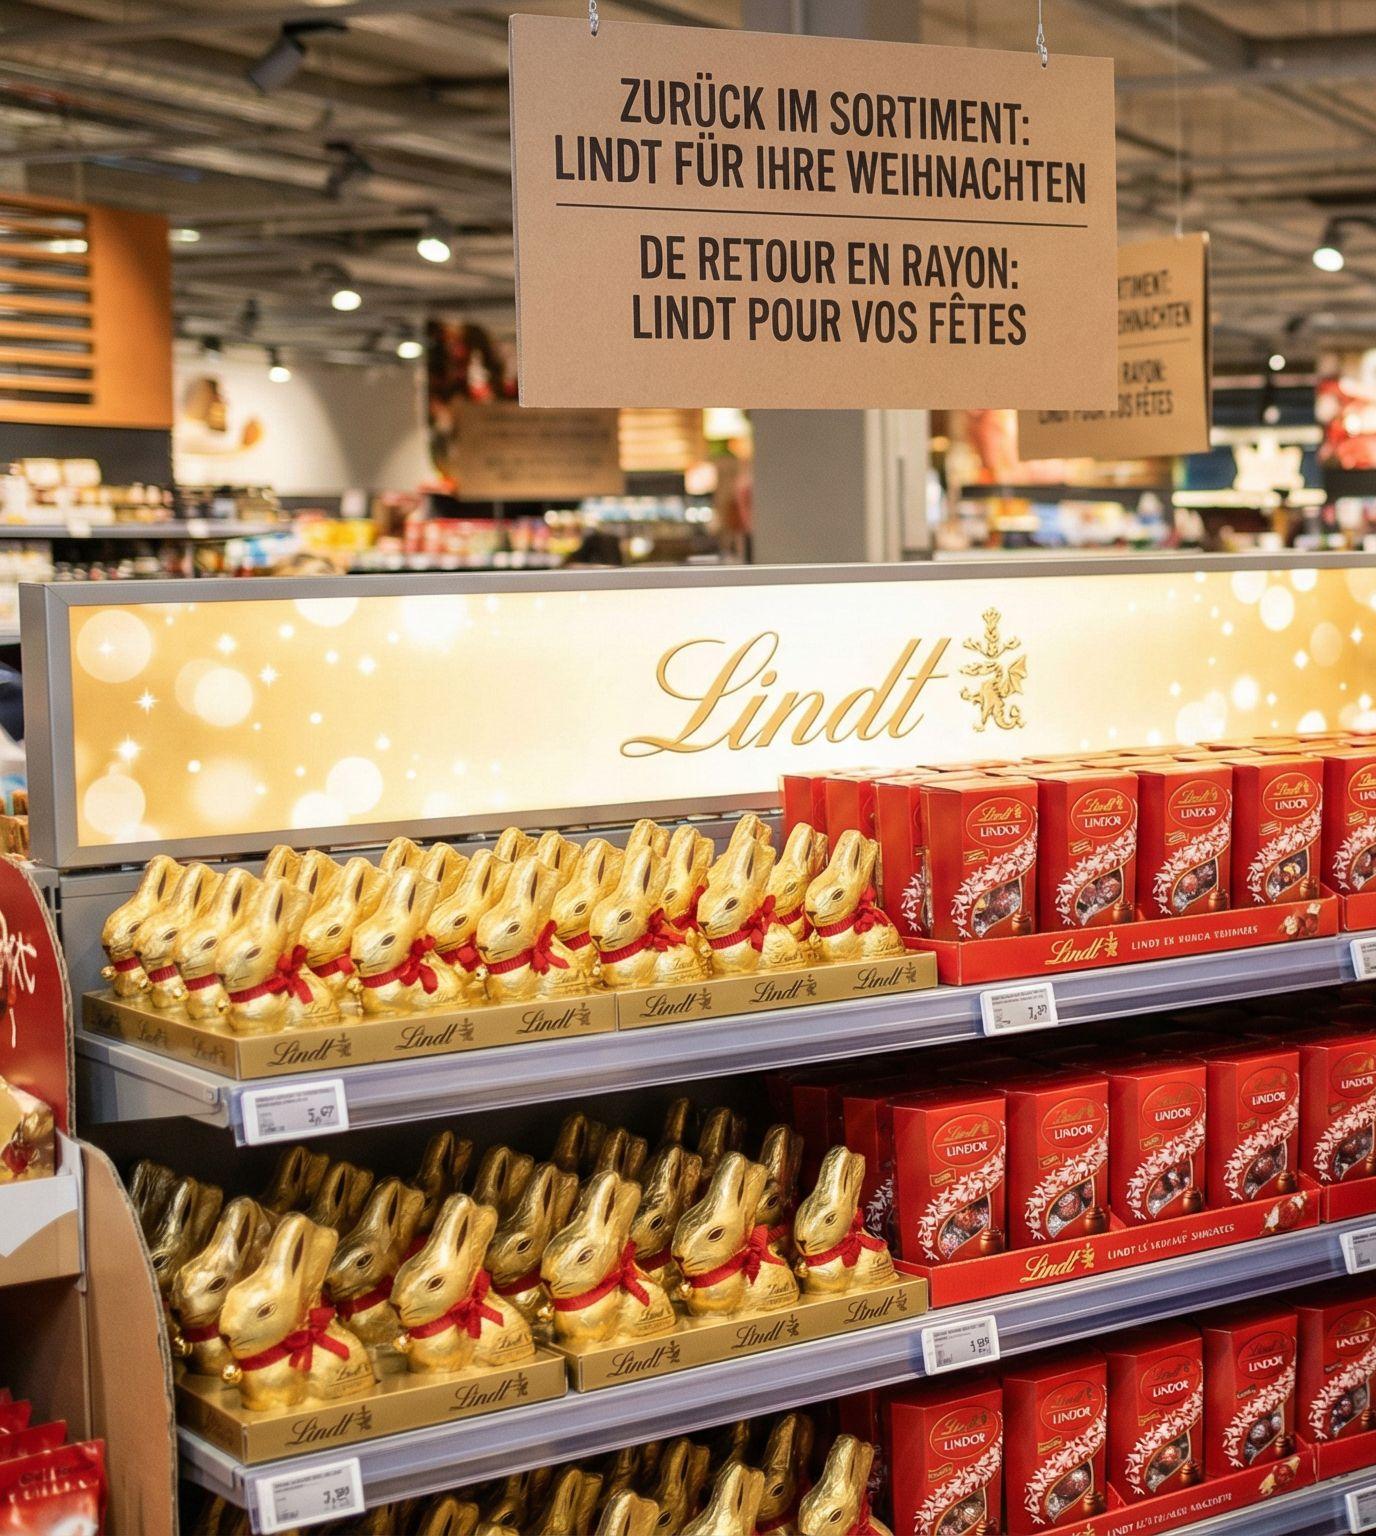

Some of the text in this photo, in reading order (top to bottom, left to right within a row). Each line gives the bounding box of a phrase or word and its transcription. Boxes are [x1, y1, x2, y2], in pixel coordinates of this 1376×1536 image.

[620, 72, 1029, 145] ZURÜCK IM SORTIMENT:
[555, 132, 1086, 204] LINDT FÜR IHRE WEIHNACHTEN
[640, 235, 1018, 289] DE RETOUR EN RAYON:
[633, 292, 1027, 345] LINDT POUR VOS FÊTES
[620, 631, 951, 757] Lindt
[1044, 938, 1103, 966] Lindt
[639, 992, 697, 1018] Lindt
[749, 979, 803, 1003] Lindt
[515, 1008, 577, 1034] Lindt
[394, 1023, 459, 1050] Lindt
[267, 1039, 338, 1068] Lindt
[1055, 1125, 1093, 1139] LINDOR
[1019, 1250, 1081, 1283] Lindt
[843, 1295, 896, 1324] Lindt
[730, 1320, 788, 1350] Lindt
[606, 1347, 668, 1378] Lindt
[449, 1379, 514, 1411] Lindt
[1053, 1406, 1091, 1424] LINDOR
[285, 1416, 355, 1446] Lindt
[944, 1432, 985, 1450] LINDOR
